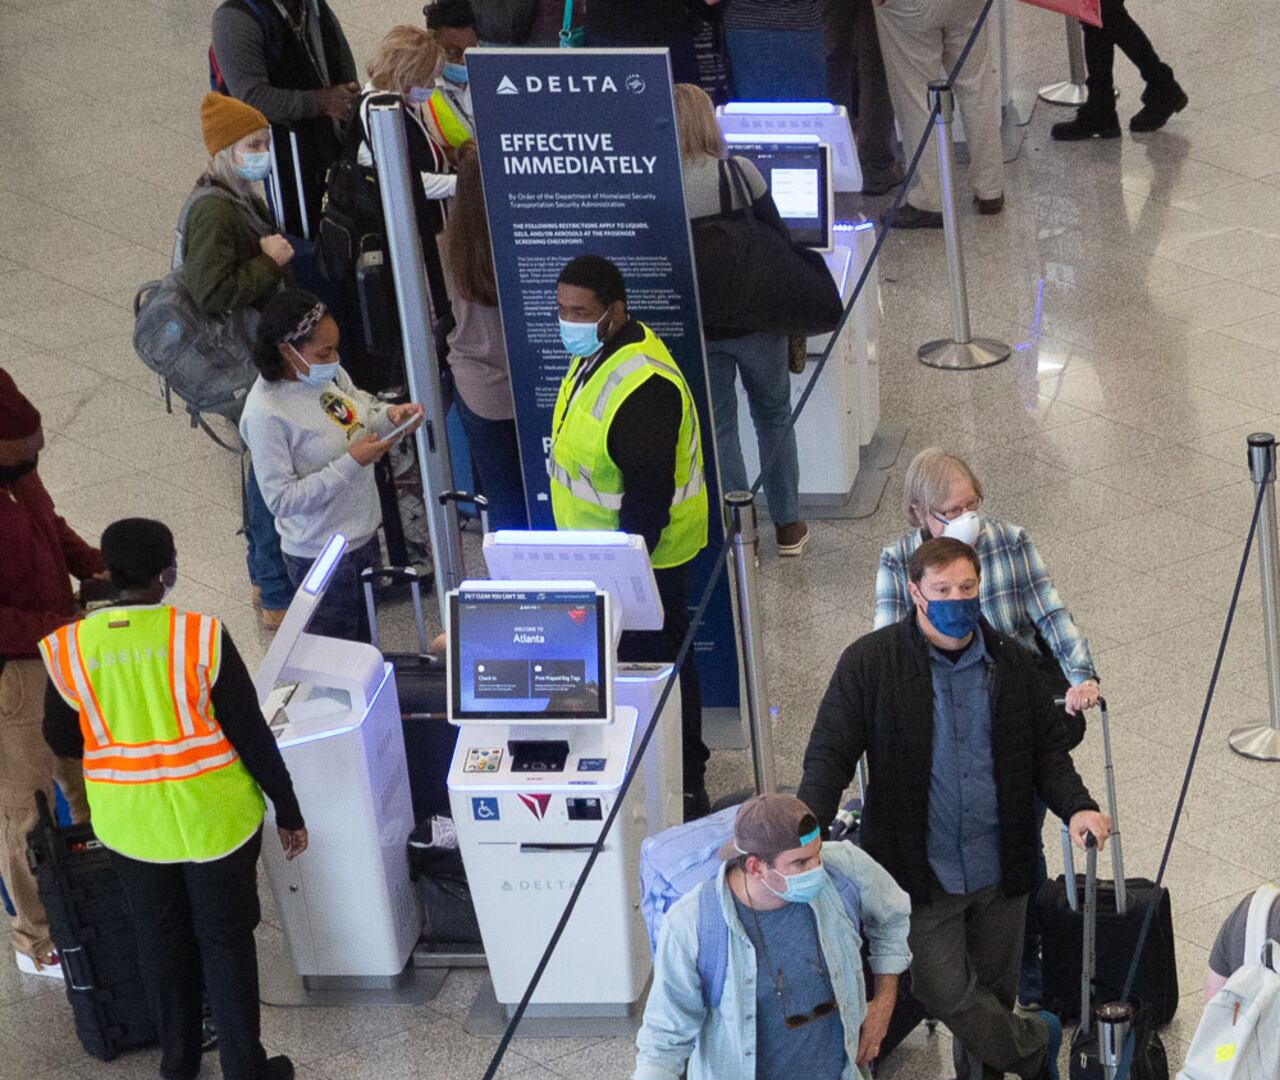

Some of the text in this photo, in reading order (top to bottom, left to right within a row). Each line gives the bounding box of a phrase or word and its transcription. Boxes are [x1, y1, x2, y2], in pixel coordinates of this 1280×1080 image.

[526, 76, 618, 93] DELTA
[500, 133, 614, 152] EFFECTIVE
[503, 155, 657, 175] IMMEDIATELY
[555, 193, 591, 201] Department
[632, 193, 656, 201] Security
[510, 201, 554, 209] Transportation
[555, 201, 579, 209] Security
[513, 633, 545, 644] Atlanta
[520, 880, 576, 890] DELTA
